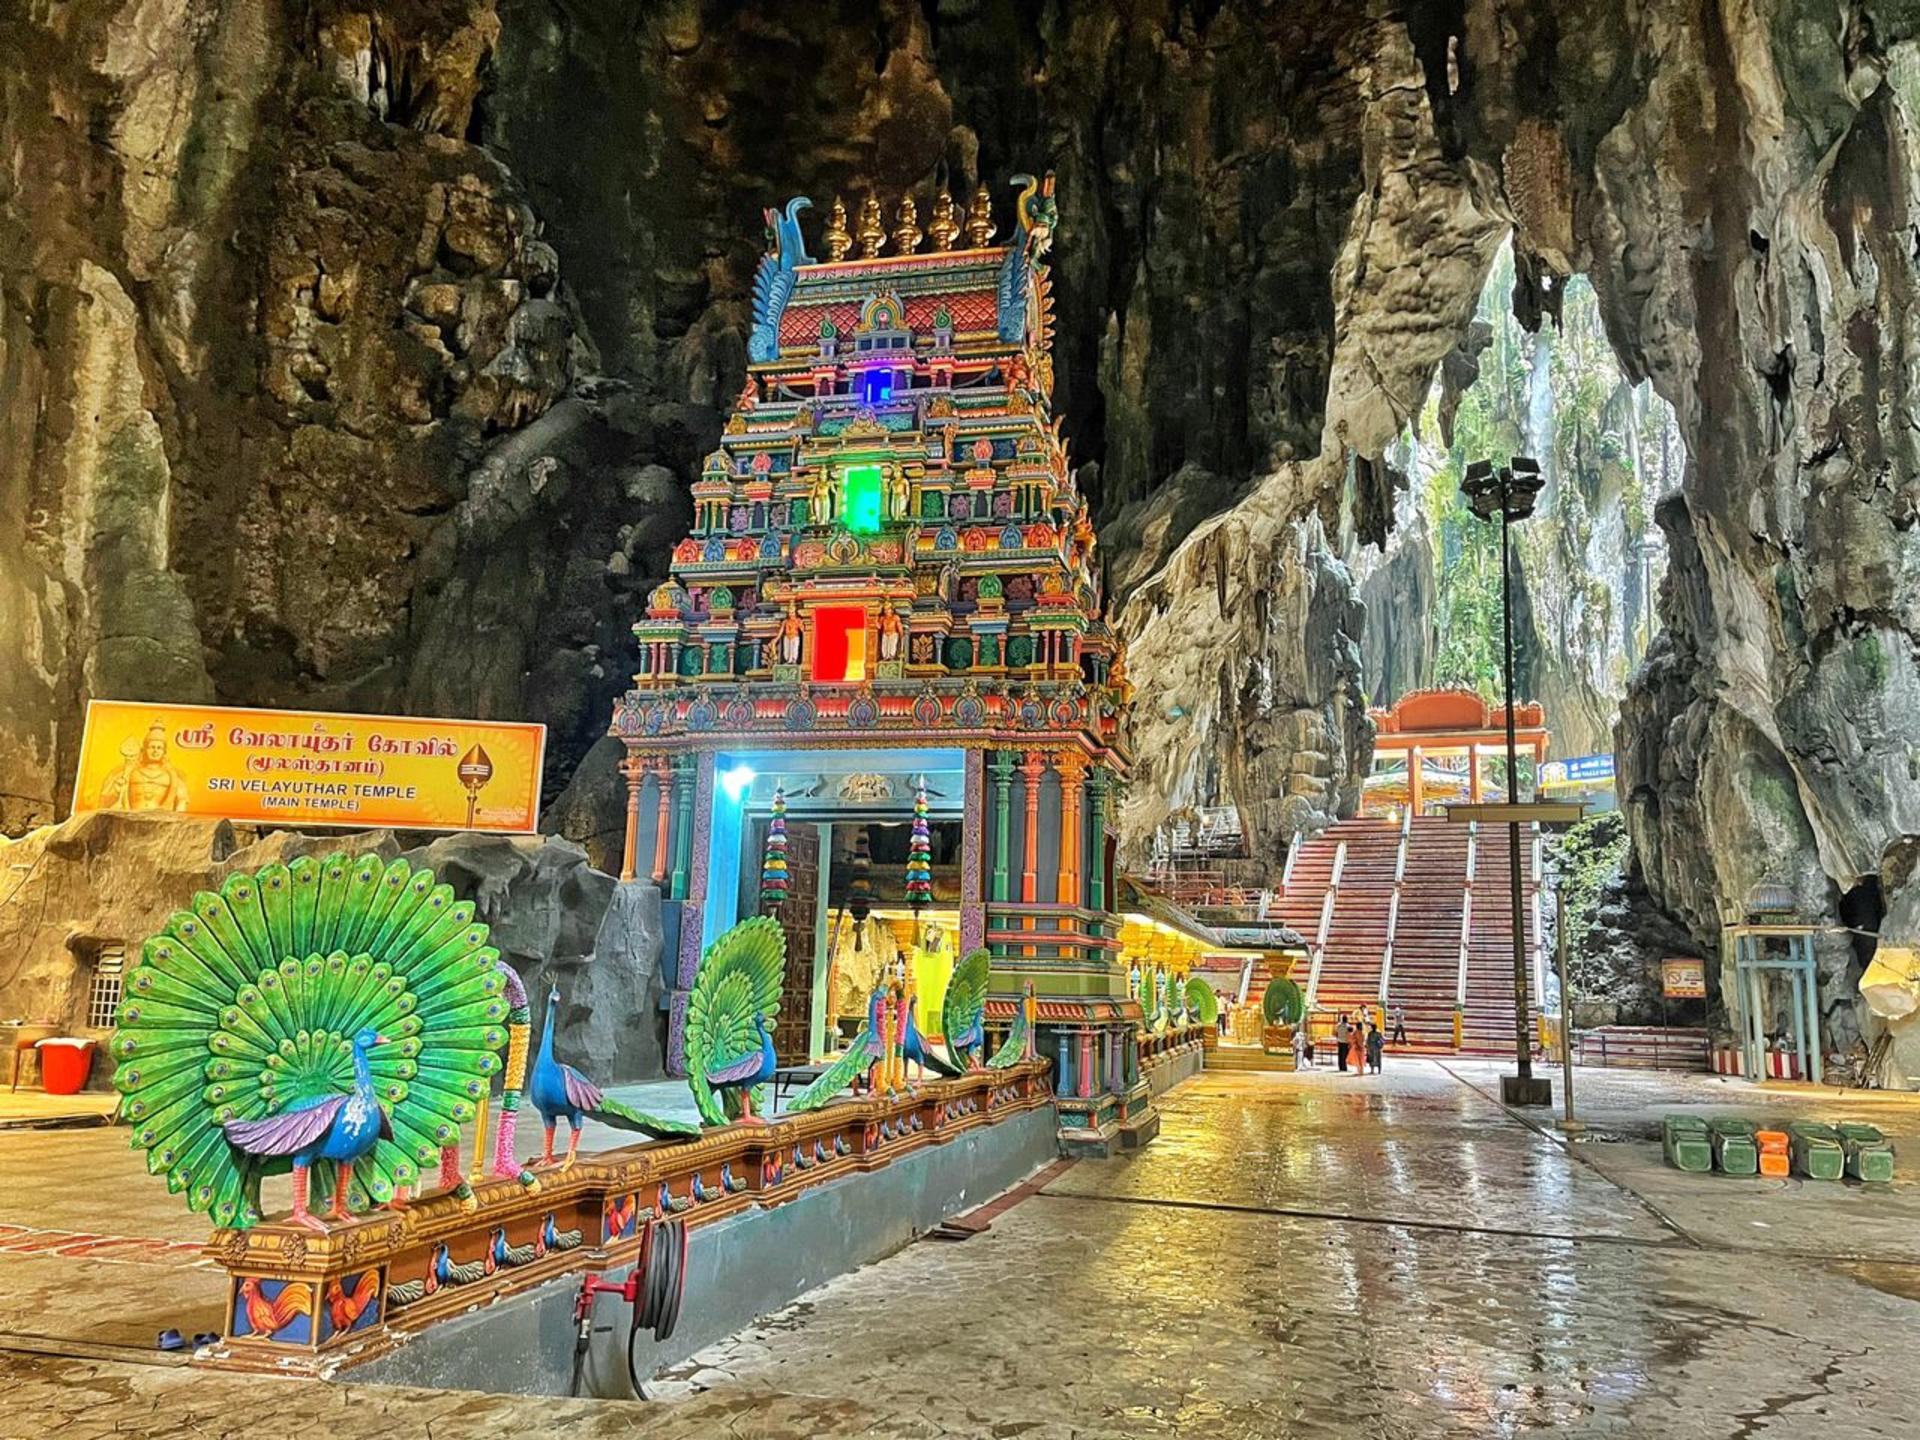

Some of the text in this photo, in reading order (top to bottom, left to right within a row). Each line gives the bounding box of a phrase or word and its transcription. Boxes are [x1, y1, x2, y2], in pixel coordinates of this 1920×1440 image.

[229, 727, 354, 754] வேலாயுதர்
[368, 735, 458, 757] கோவில்
[208, 778, 416, 799] SRI VELAYUTHAR TEMPLE
[262, 797, 360, 811] (MAIN TEMPLE)
